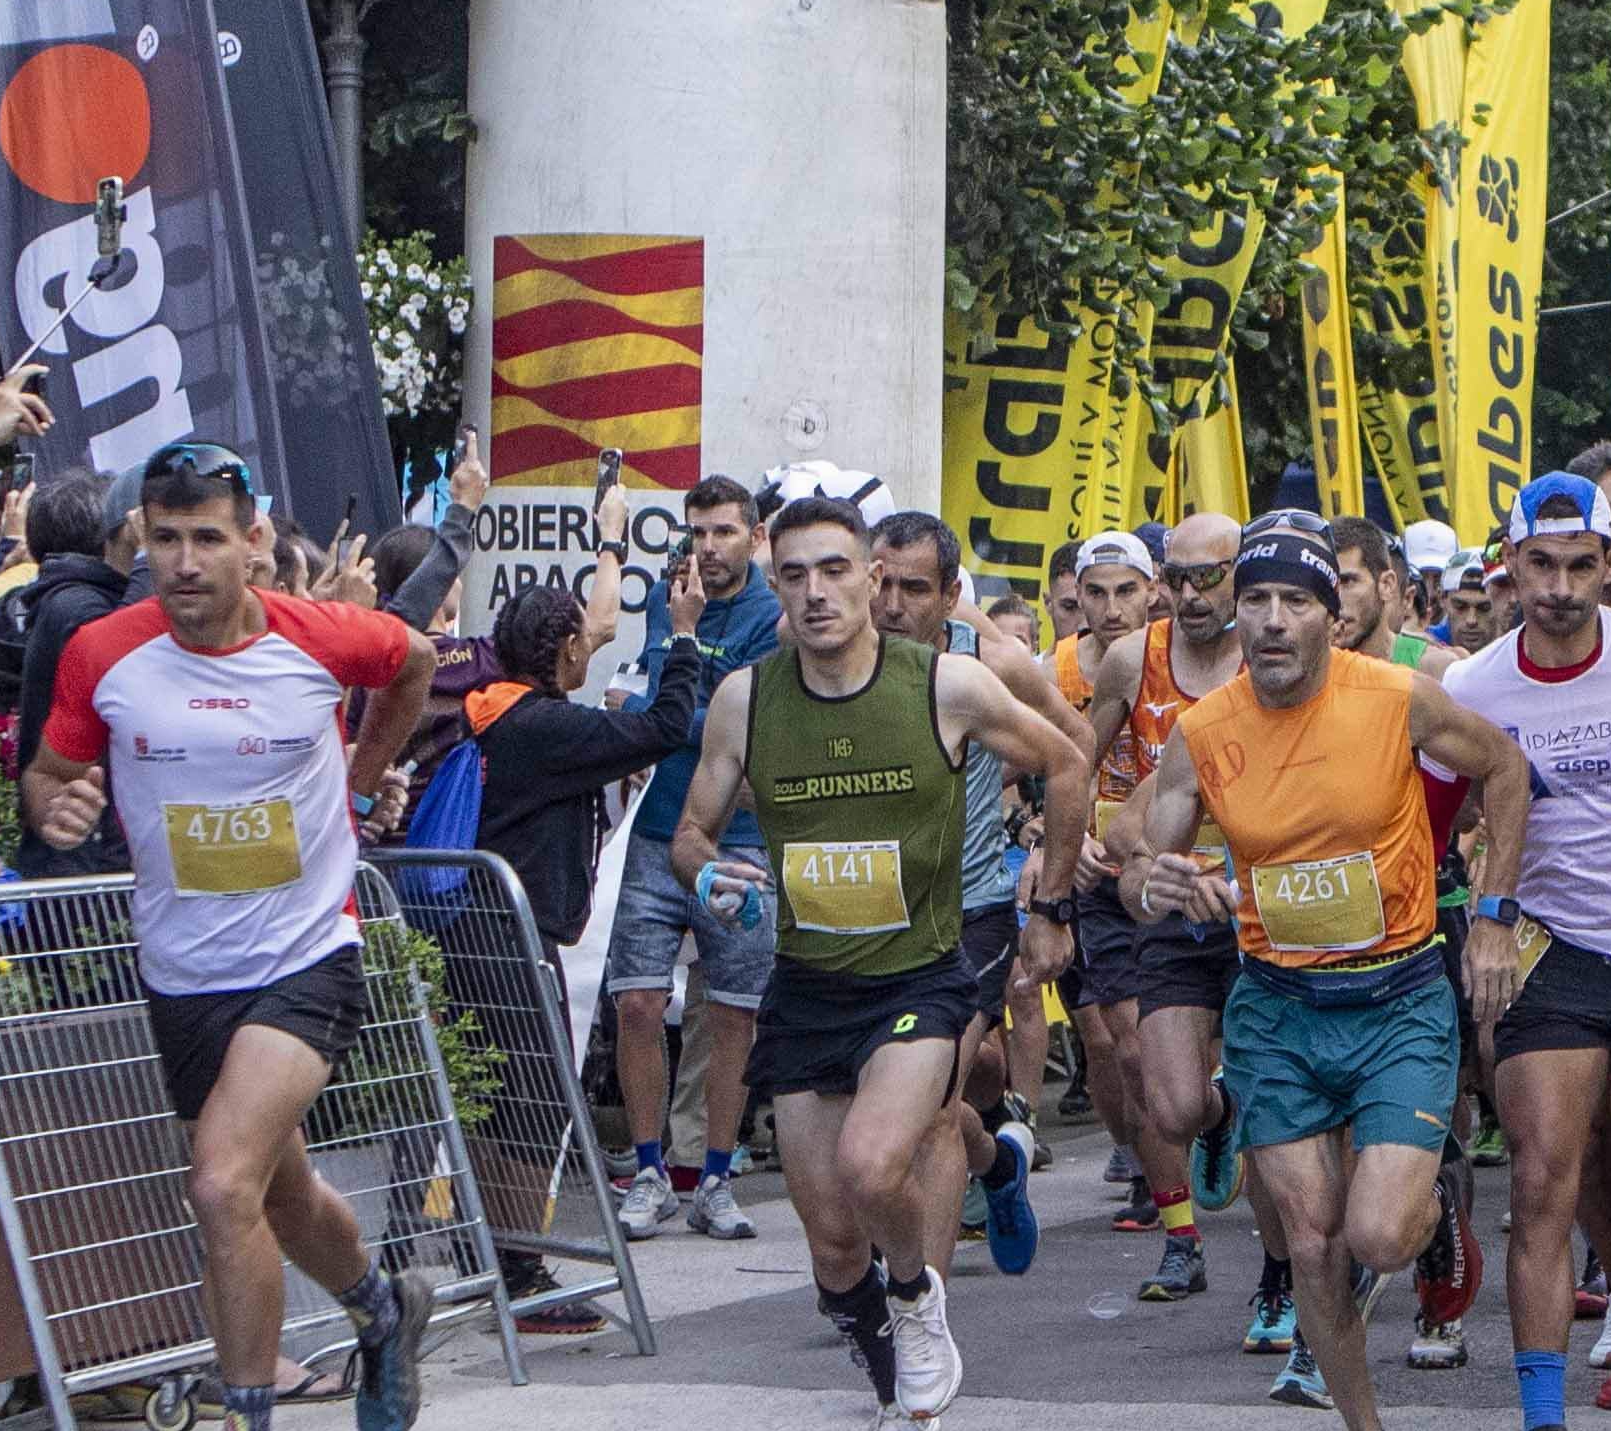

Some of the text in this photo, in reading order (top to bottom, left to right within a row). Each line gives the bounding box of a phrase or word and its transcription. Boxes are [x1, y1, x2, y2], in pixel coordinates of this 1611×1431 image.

[806, 768, 915, 800] RUNNERS
[186, 808, 272, 844] 4763
[801, 853, 875, 886] 4141
[1276, 867, 1350, 905] 4261
